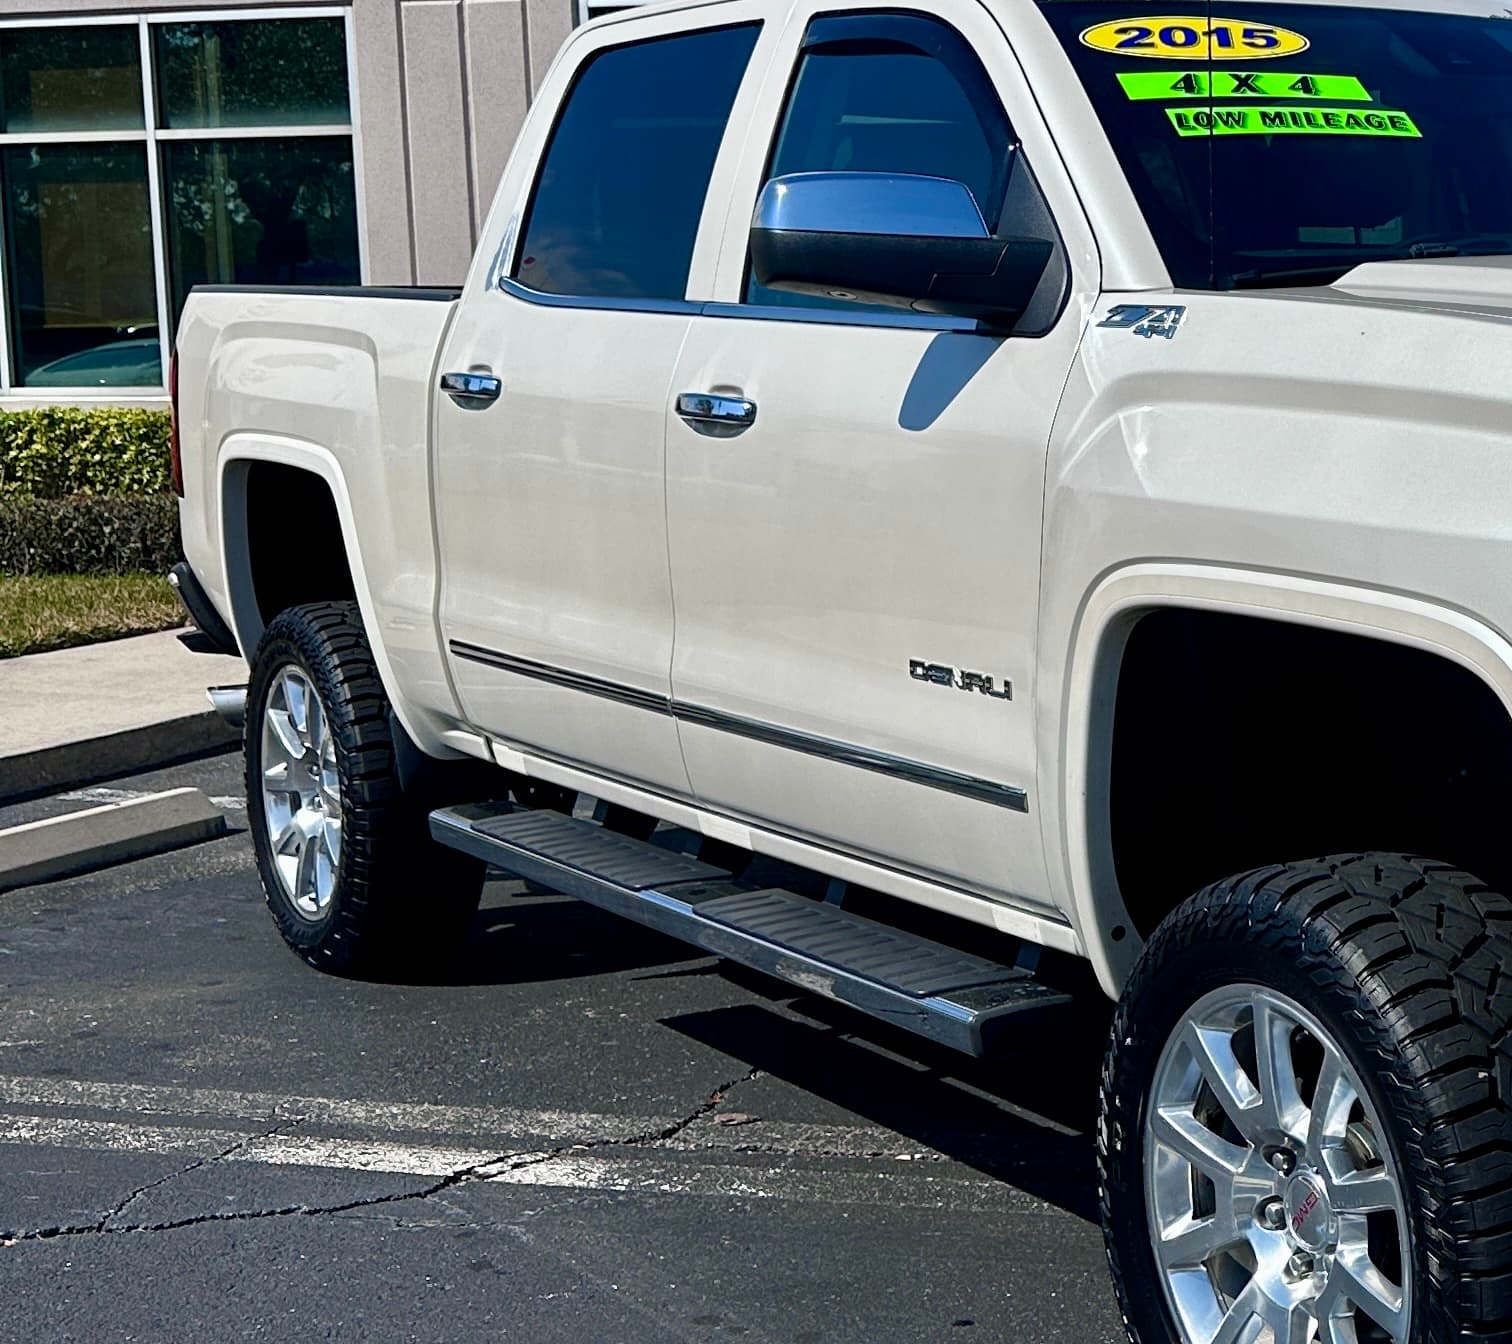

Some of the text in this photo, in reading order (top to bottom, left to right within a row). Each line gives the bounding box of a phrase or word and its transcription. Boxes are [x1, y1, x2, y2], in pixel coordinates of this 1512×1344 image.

[1113, 25, 1279, 51] 2015
[1174, 111, 1411, 134] LOW MILEAGE
[1291, 1191, 1319, 1233] GMC
